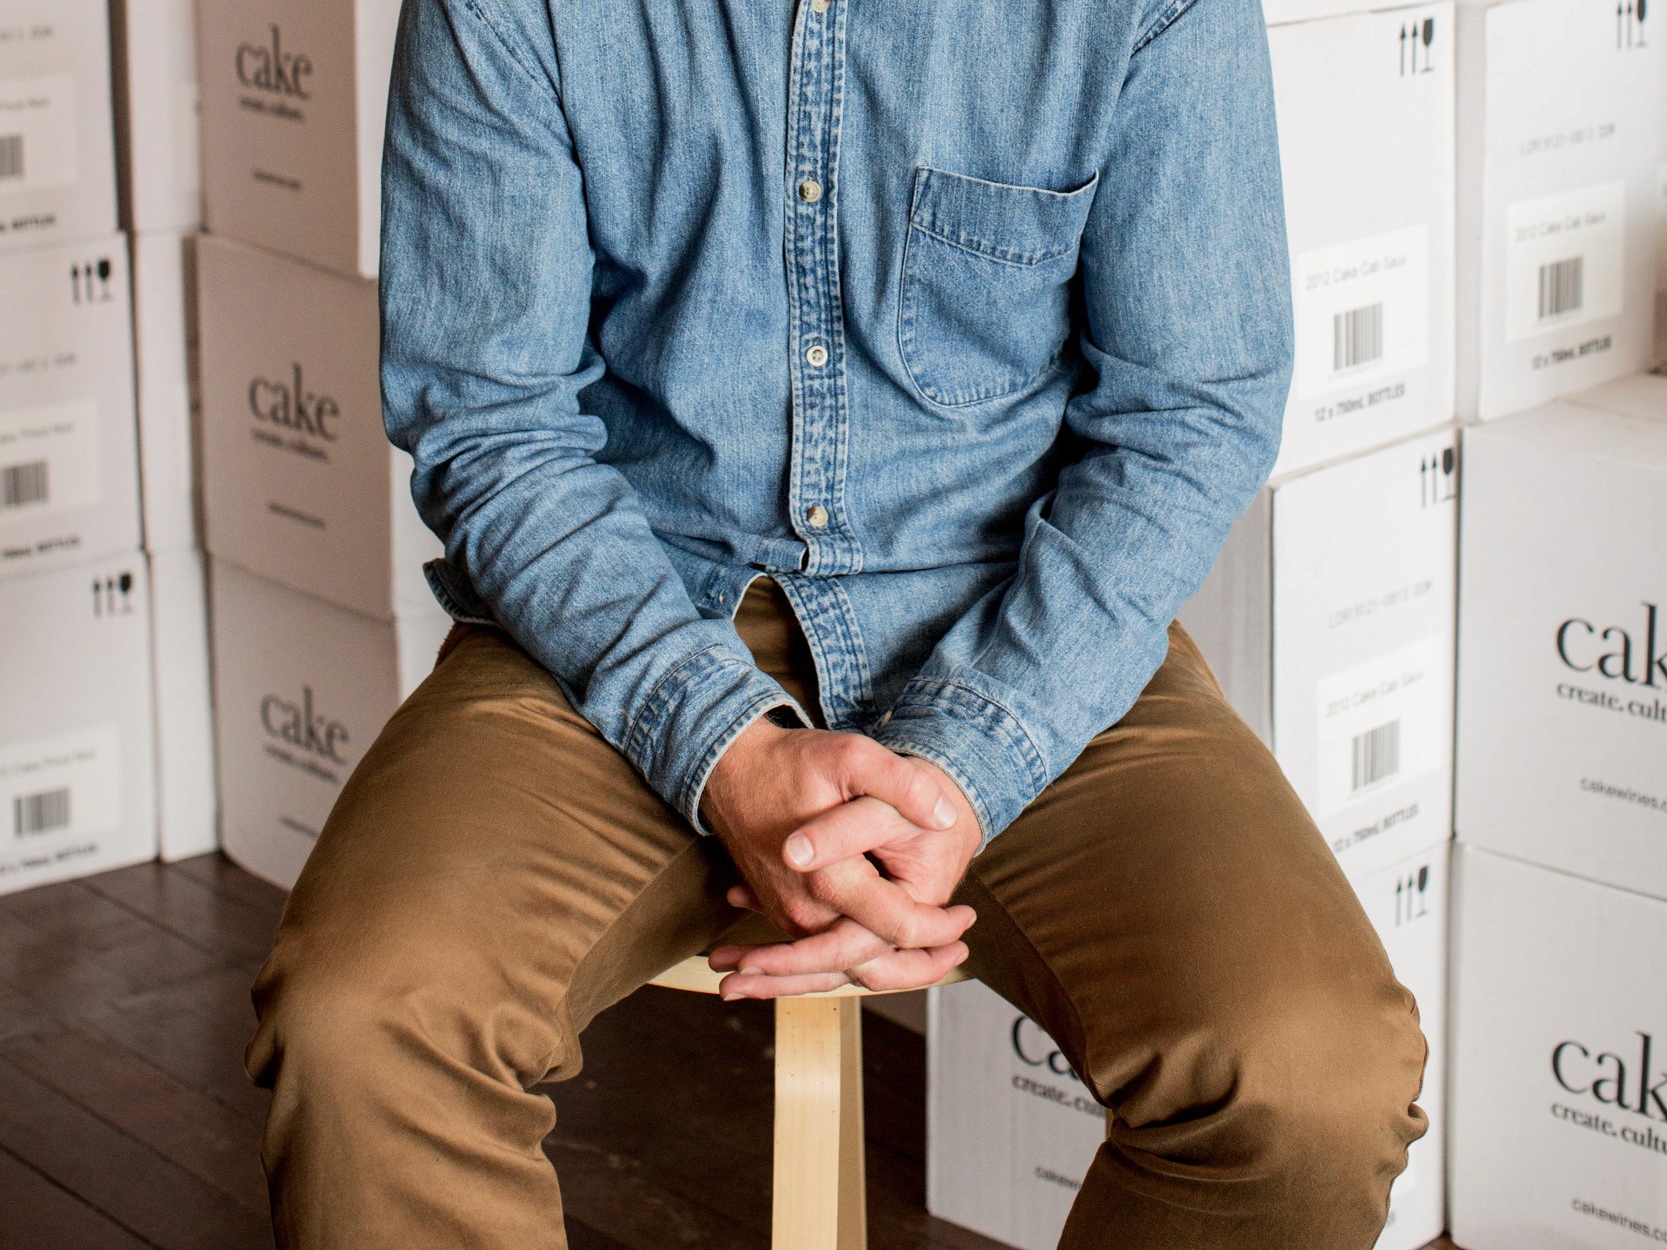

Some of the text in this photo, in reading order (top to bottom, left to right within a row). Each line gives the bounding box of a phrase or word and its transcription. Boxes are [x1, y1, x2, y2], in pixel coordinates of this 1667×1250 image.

[236, 23, 313, 100] cake
[249, 363, 341, 442] cake
[261, 686, 349, 767] cake
[1557, 683, 1624, 712] create.
[1551, 1103, 1617, 1137] create.
